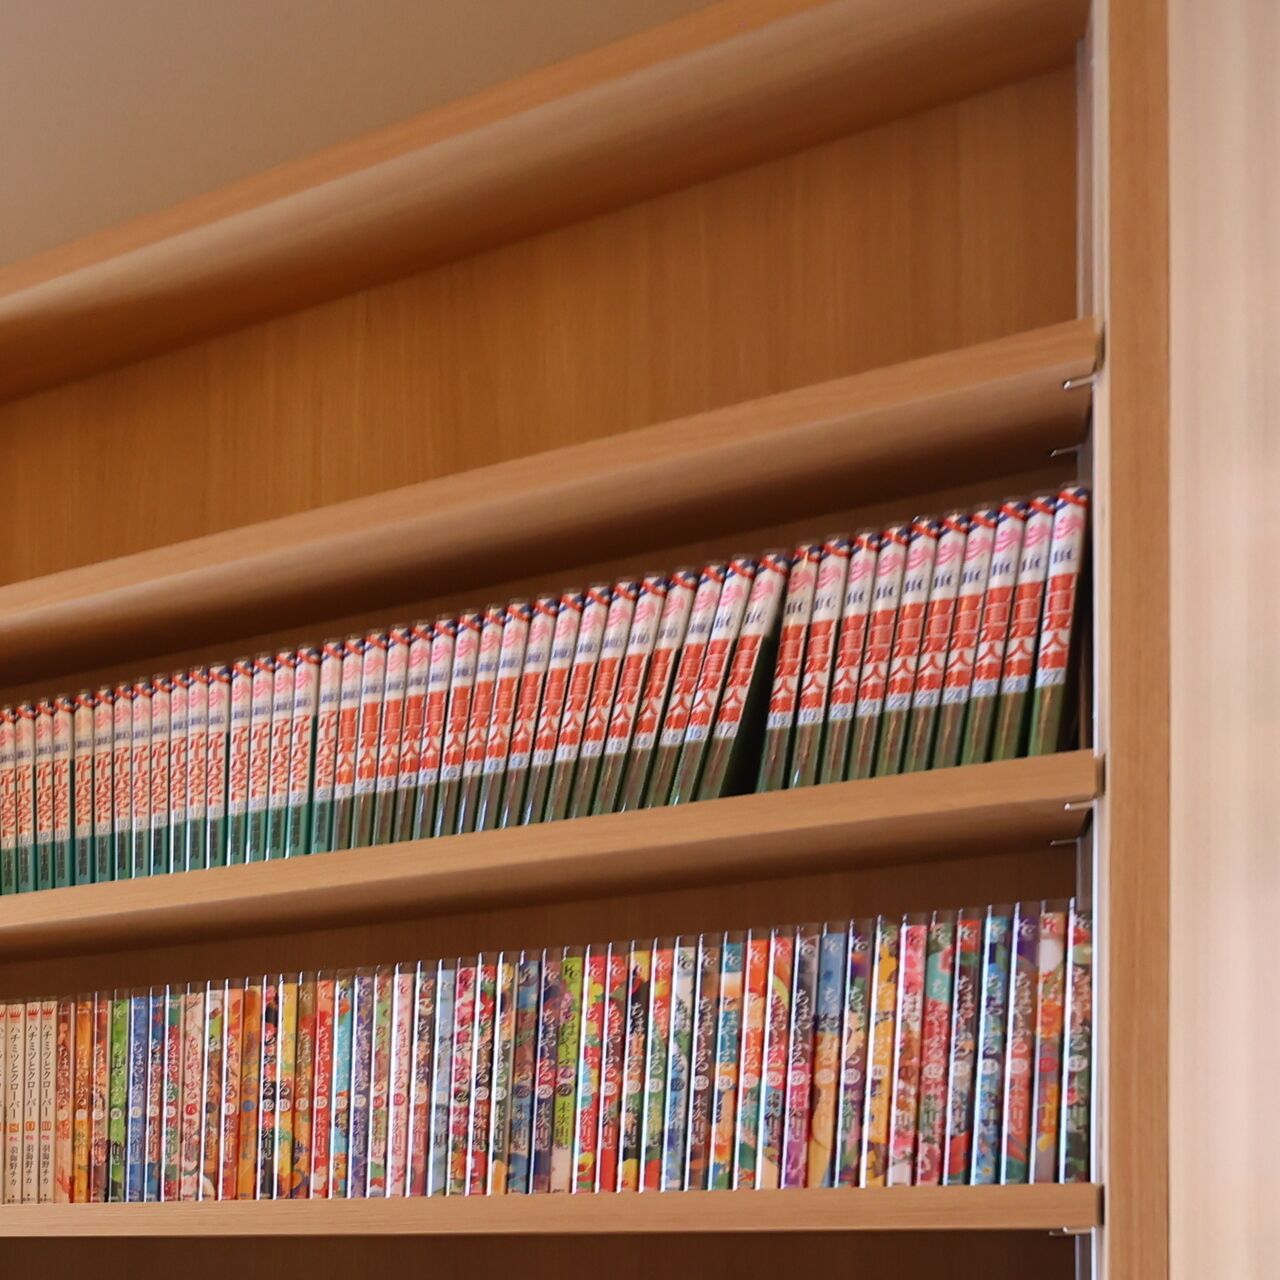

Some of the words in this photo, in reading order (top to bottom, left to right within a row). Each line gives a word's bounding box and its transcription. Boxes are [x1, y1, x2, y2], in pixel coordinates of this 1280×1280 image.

[10, 1027, 20, 1118] ハチミツとクローバー
[27, 1024, 37, 1116] ハチミツとクローバー
[43, 1024, 52, 1117] ハチミツとクローバー
